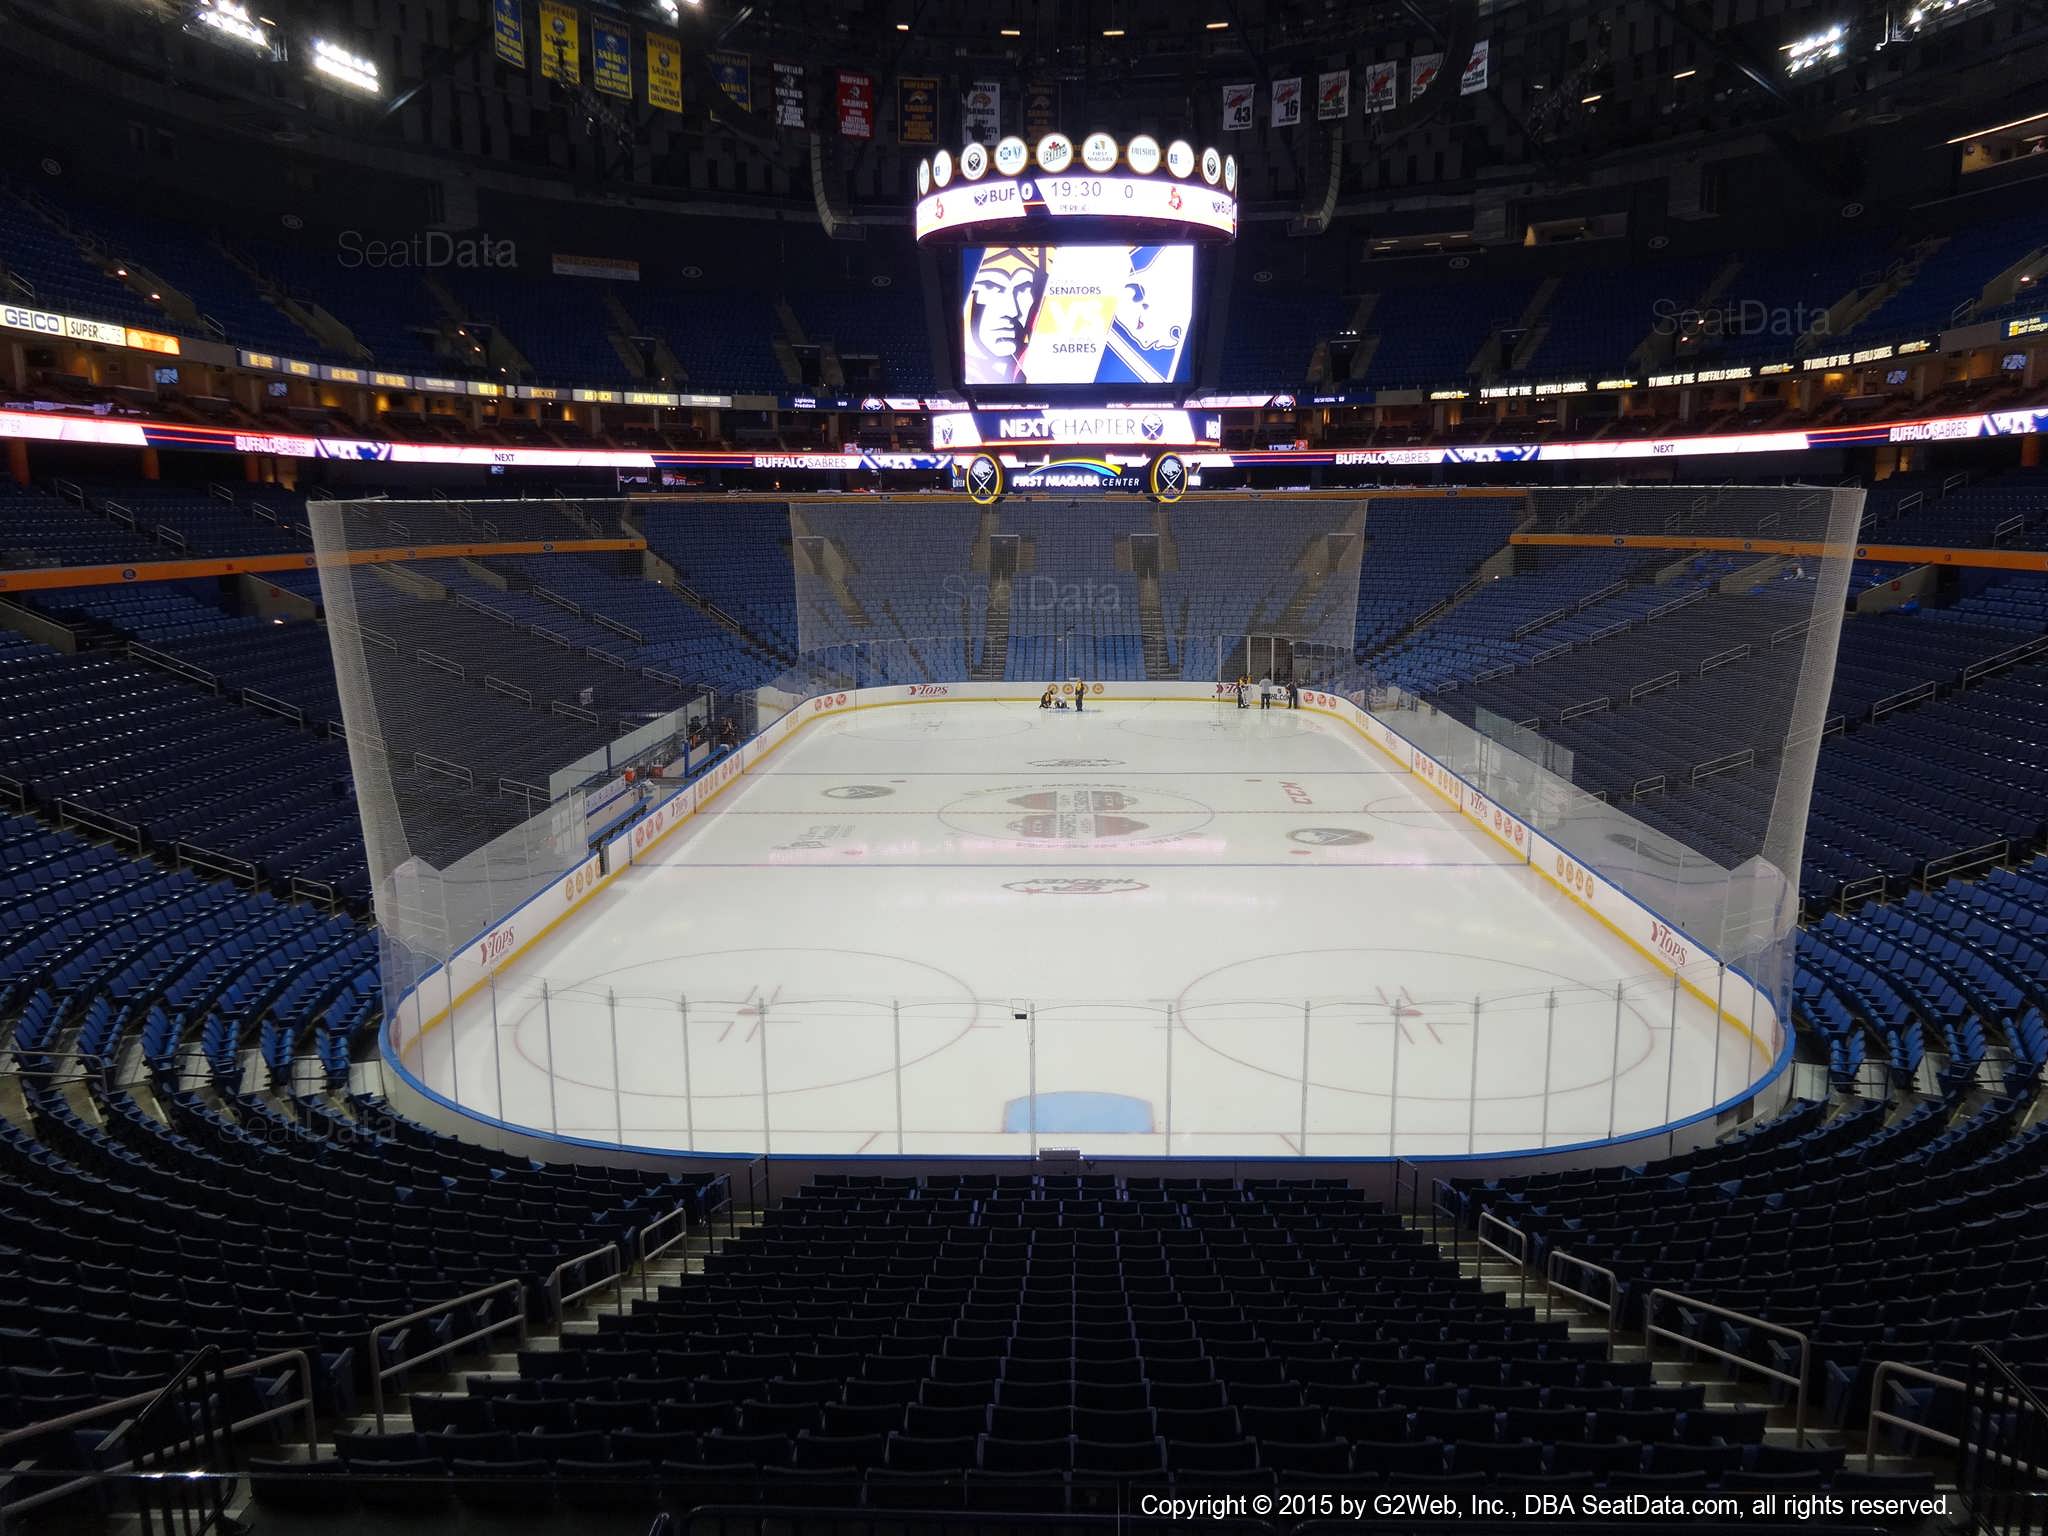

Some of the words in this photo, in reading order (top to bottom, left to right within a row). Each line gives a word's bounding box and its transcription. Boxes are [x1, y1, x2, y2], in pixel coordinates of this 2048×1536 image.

[1233, 106, 1251, 123] 43
[1282, 100, 1298, 117] 16
[989, 188, 1016, 203] BUF
[1051, 181, 1103, 198] 19:30
[1049, 286, 1101, 296] SENATORS
[4, 308, 60, 333] GEICO
[1052, 343, 1097, 354] SABRES
[1480, 389, 1489, 399] TV
[1489, 387, 1508, 398] HOME
[1509, 387, 1518, 397] OF
[1519, 386, 1532, 396] THE
[1536, 383, 1562, 395] BUFFALO
[1653, 444, 1675, 454] NEXT
[494, 452, 515, 462] NEXT
[1012, 476, 1042, 488] FIRST
[1045, 475, 1099, 488] NIAGARA
[1102, 477, 1140, 488] CENTER
